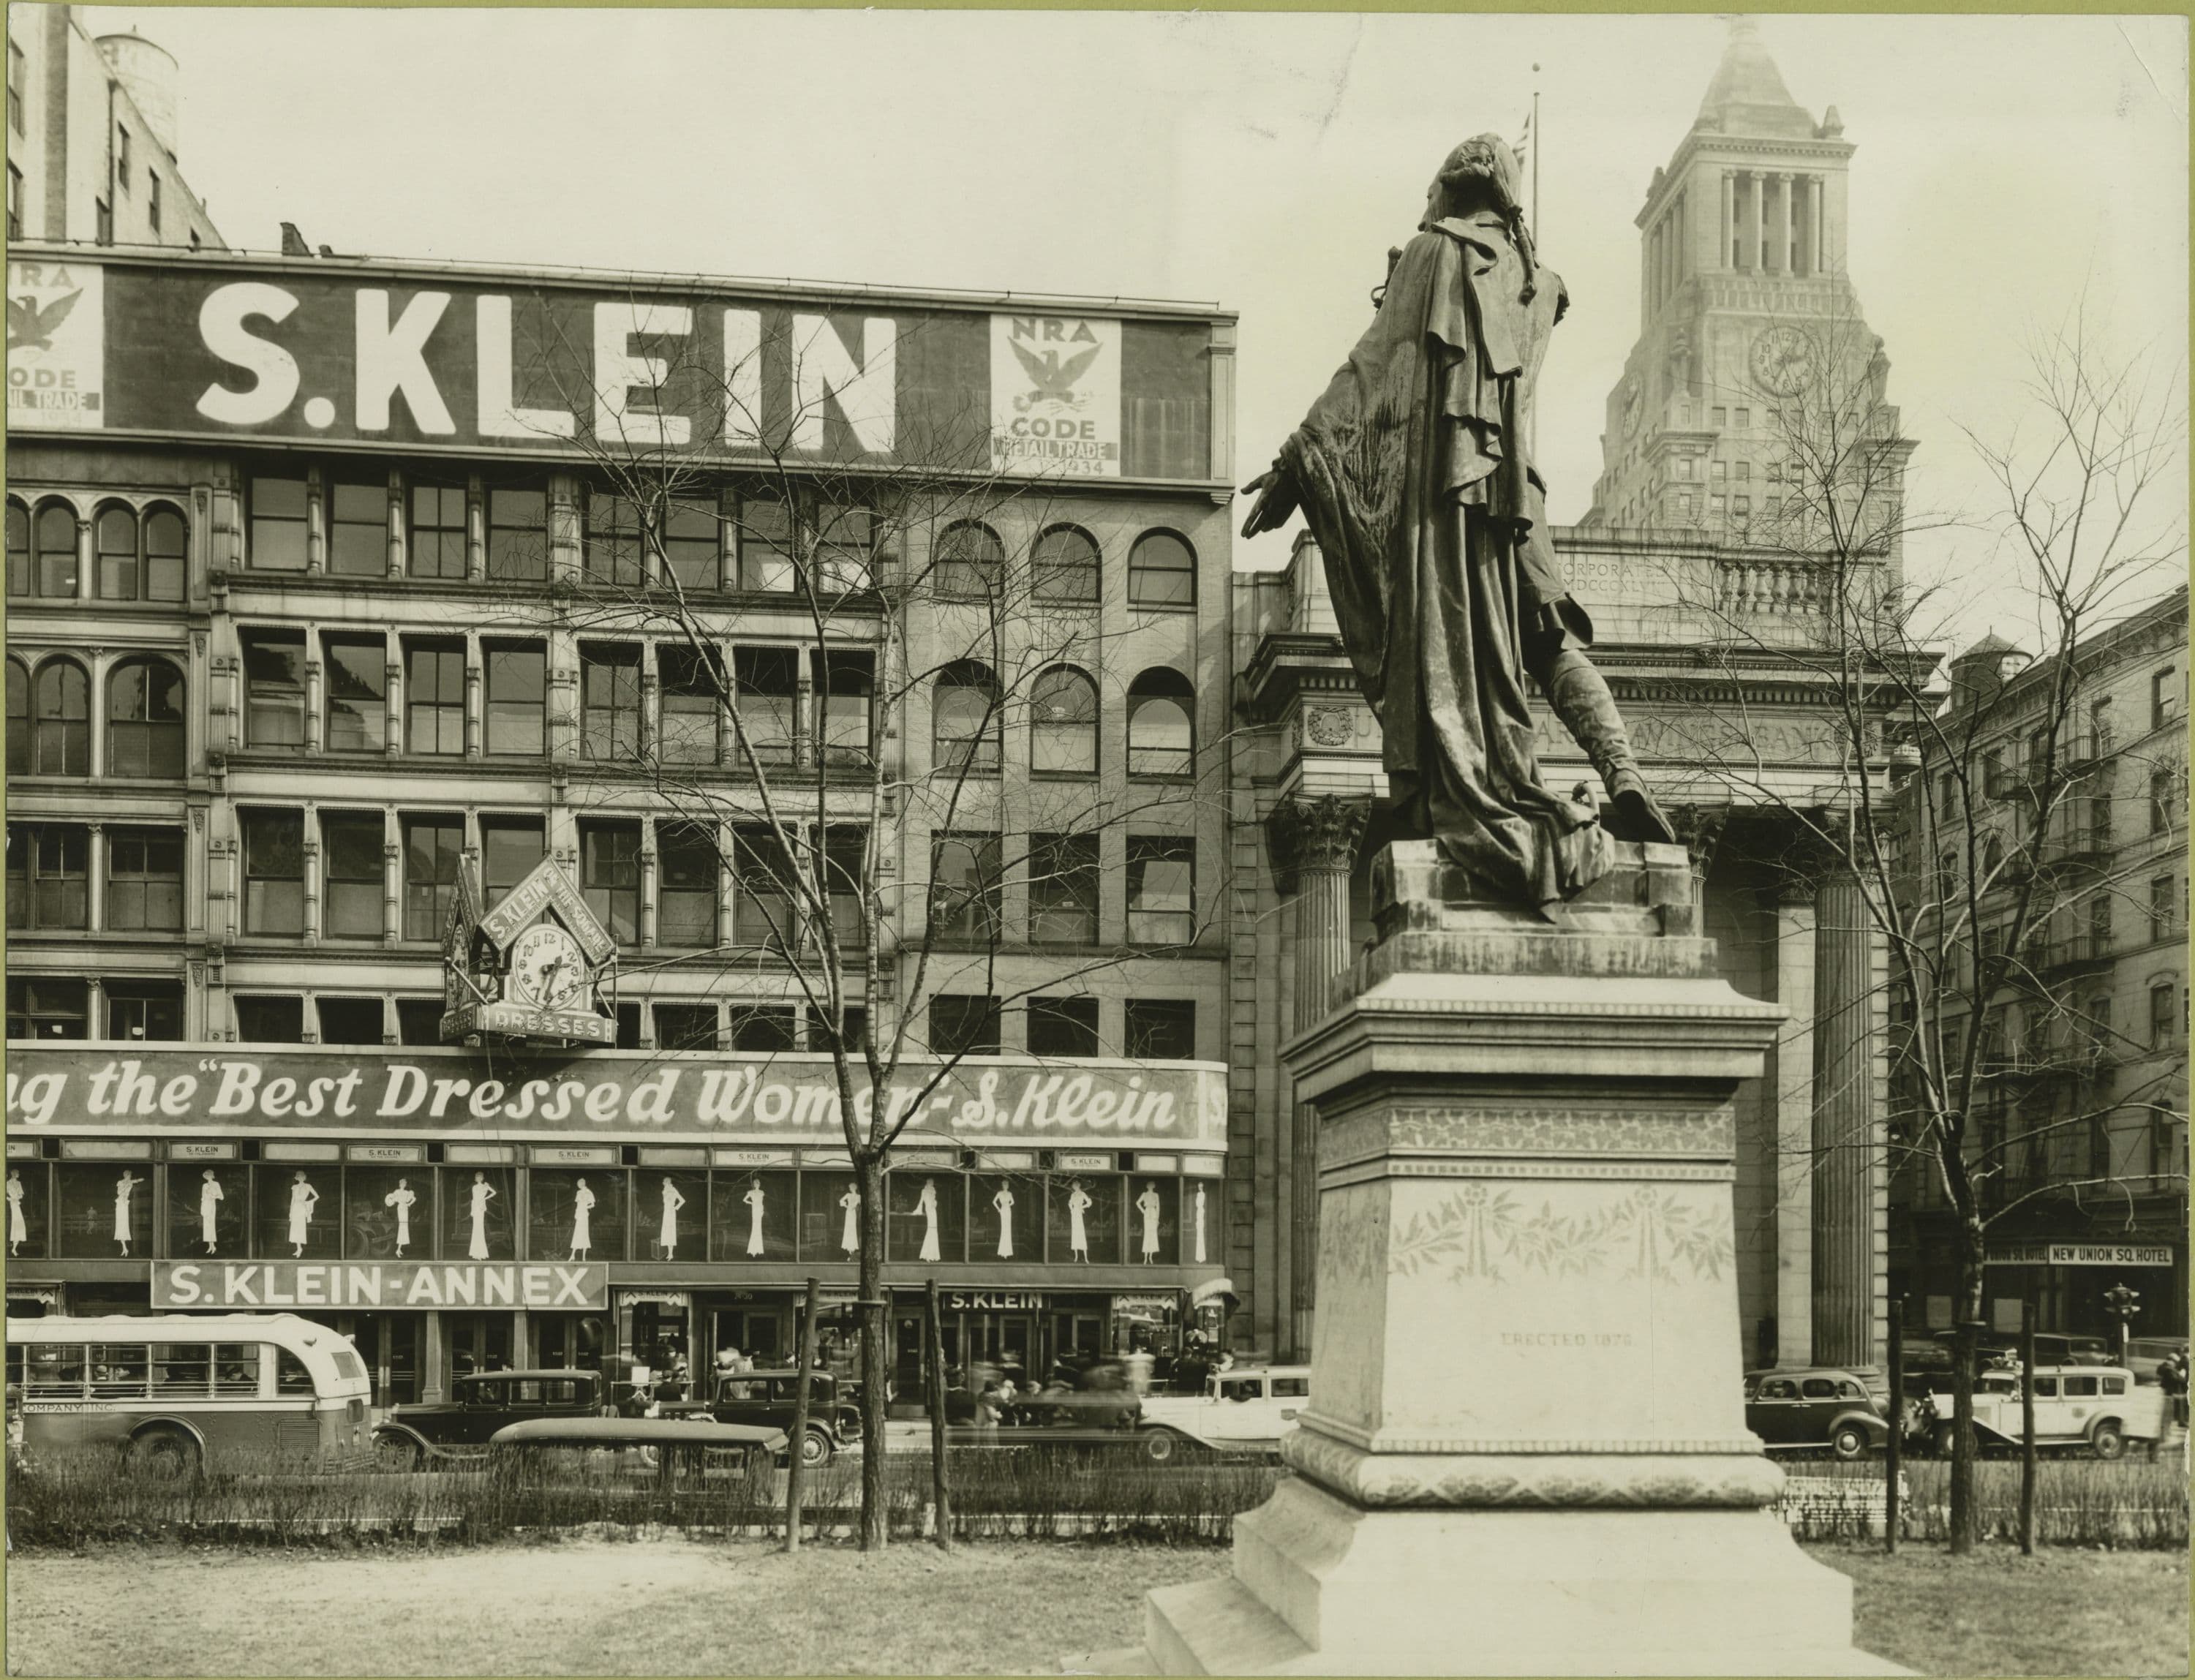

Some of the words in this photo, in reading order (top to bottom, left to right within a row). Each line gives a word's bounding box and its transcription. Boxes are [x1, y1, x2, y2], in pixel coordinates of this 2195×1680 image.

[9, 263, 75, 288] RA
[1012, 317, 1098, 344] NRA
[7, 366, 76, 389] ODE
[34, 391, 88, 411] TRADE
[1011, 416, 1096, 440] CODE
[1056, 440, 1108, 461] TRADE
[1063, 460, 1104, 475] 934
[1559, 562, 1665, 578] ORPORATED
[544, 933, 557, 944] 12
[523, 943, 534, 957] 10
[567, 952, 577, 963] 2
[530, 986, 541, 1001] 7
[495, 1011, 600, 1037] DRESSES
[87, 1060, 197, 1116] the
[376, 1065, 676, 1123] Dressed
[2052, 1247, 2074, 1262] NEW
[2079, 1248, 2113, 1262] UNION
[2136, 1248, 2170, 1263] HOTEL
[1501, 1332, 1587, 1346] ERECTED
[90, 1403, 116, 1412] INC.
